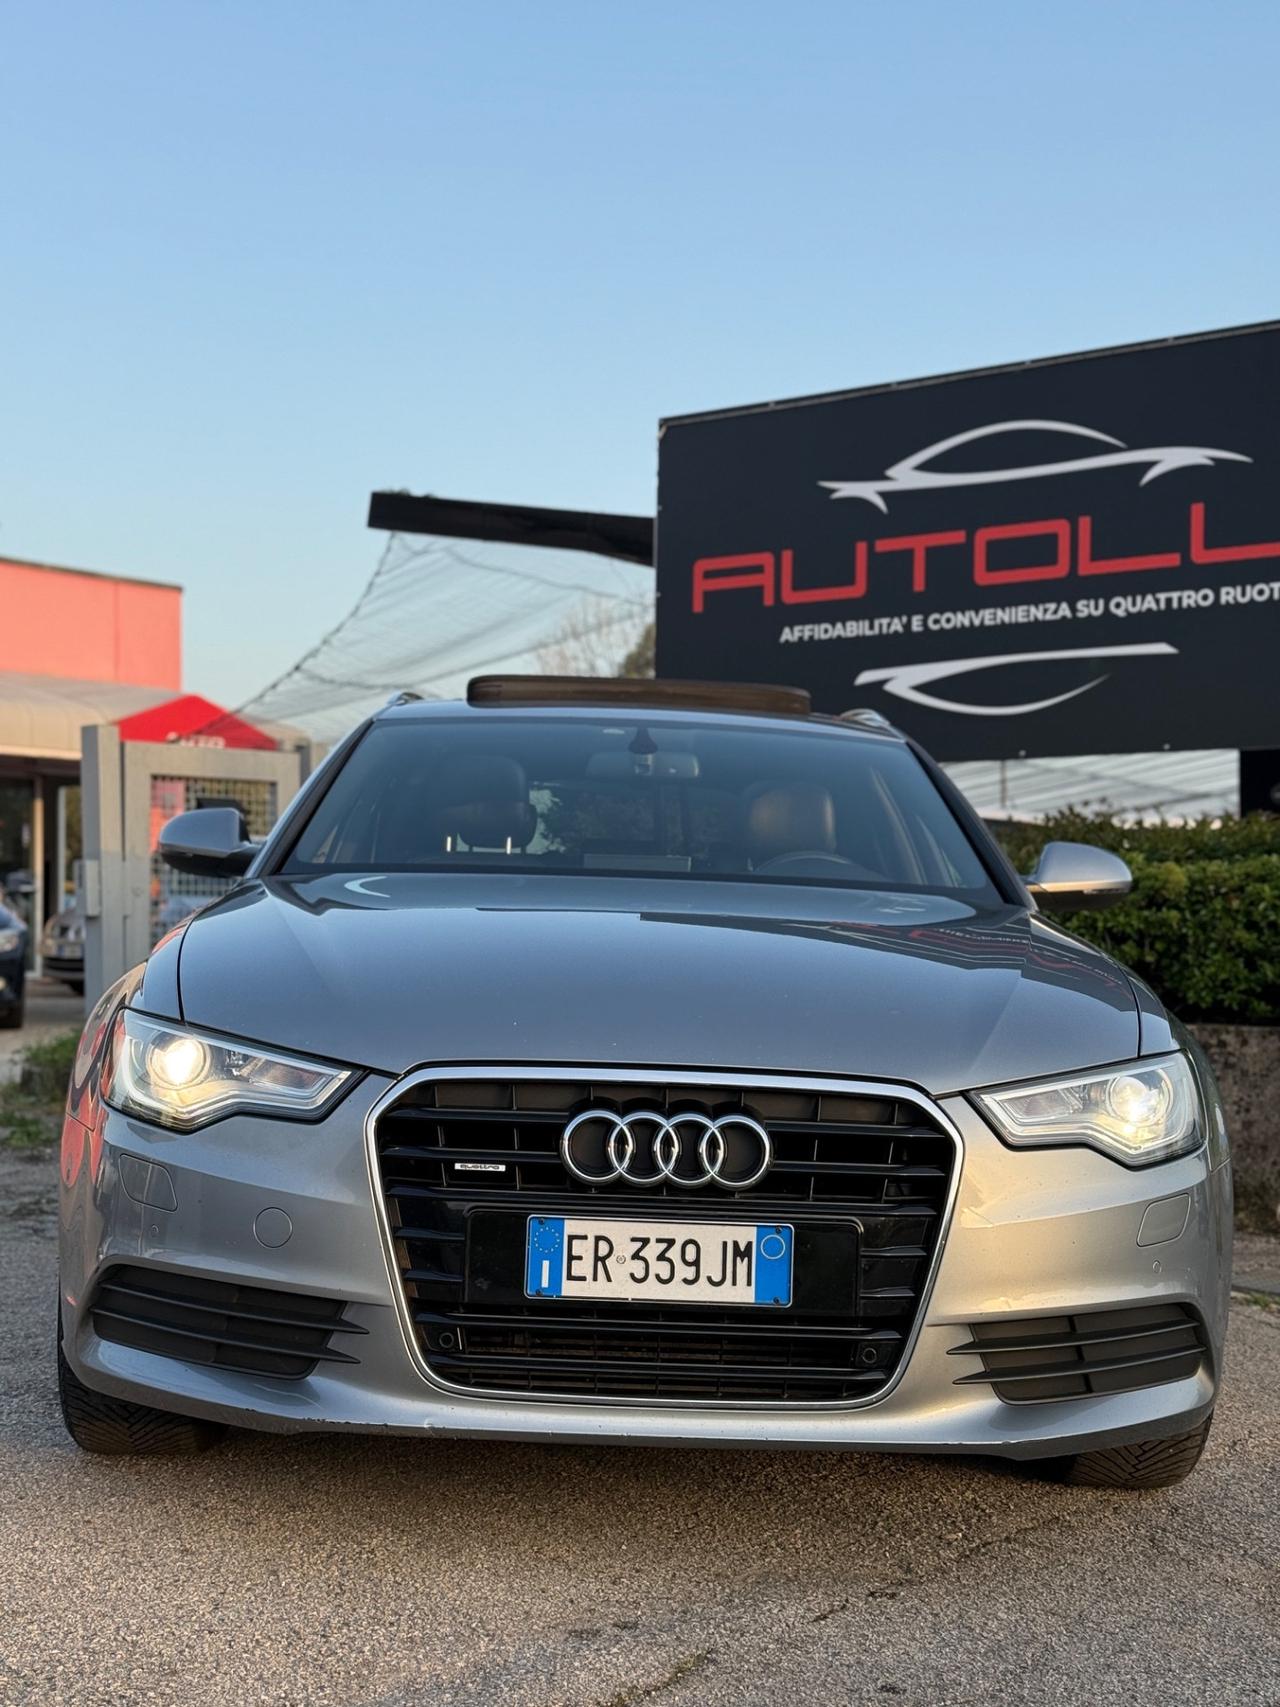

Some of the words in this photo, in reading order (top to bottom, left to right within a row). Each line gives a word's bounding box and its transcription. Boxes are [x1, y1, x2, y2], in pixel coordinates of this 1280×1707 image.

[779, 615, 908, 643] AFFIDABILITA'
[911, 615, 924, 632] E
[927, 601, 1073, 631] CONVENIENZA
[1075, 598, 1105, 618] SU
[1109, 587, 1215, 617] QUATTRO
